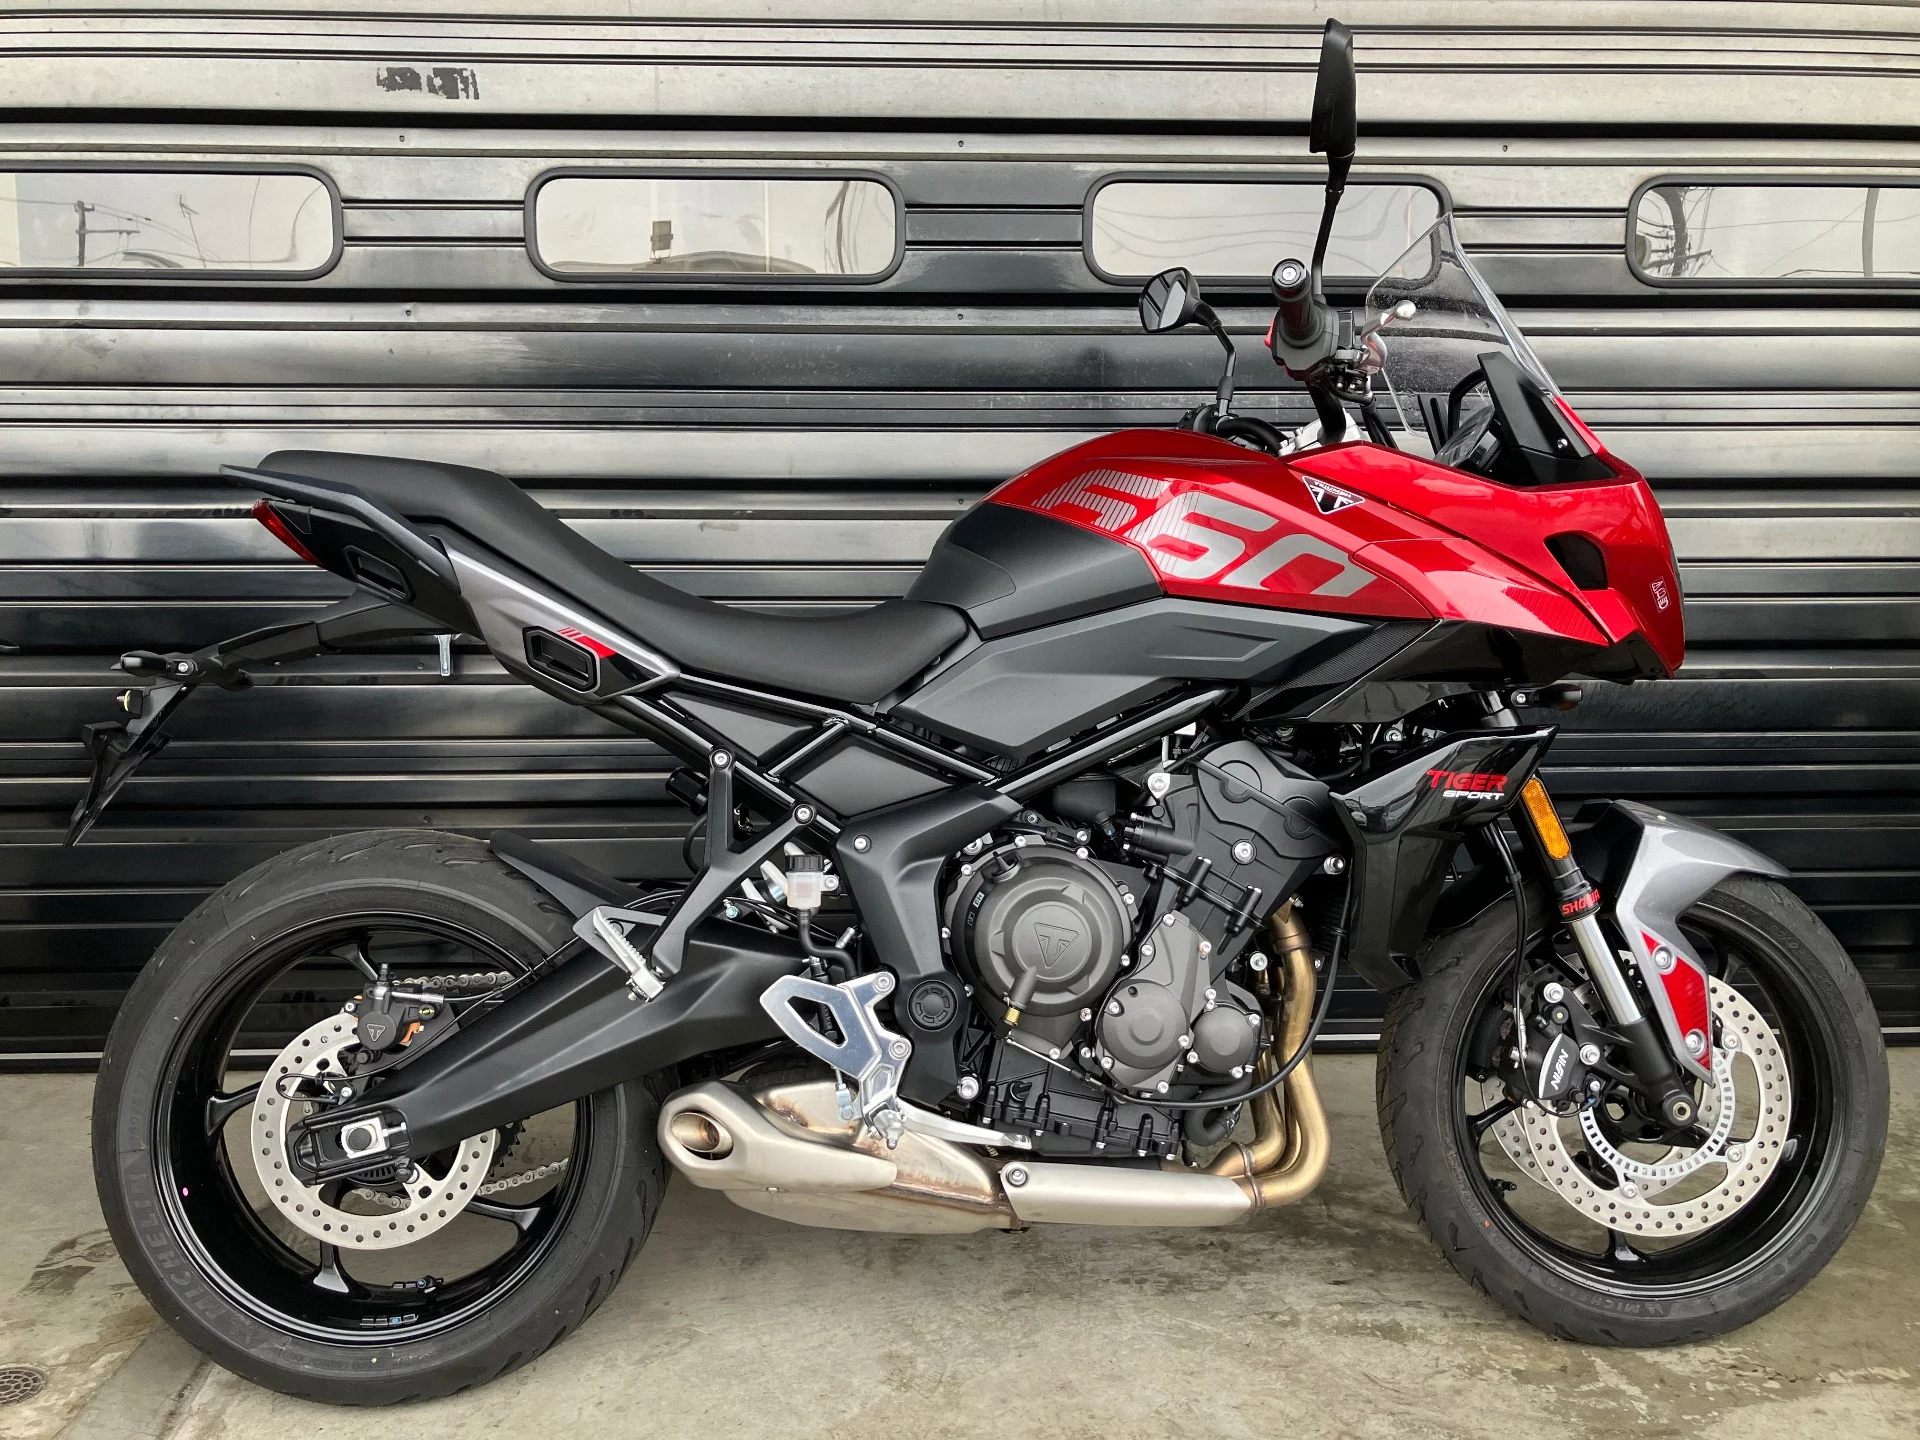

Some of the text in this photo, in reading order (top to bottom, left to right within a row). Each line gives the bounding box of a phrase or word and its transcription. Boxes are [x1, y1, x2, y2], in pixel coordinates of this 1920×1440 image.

[1031, 469, 1379, 597] 660
[1427, 769, 1508, 792] TIGER
[1443, 790, 1505, 800] SPORT
[127, 1173, 228, 1320] MICHELIN
